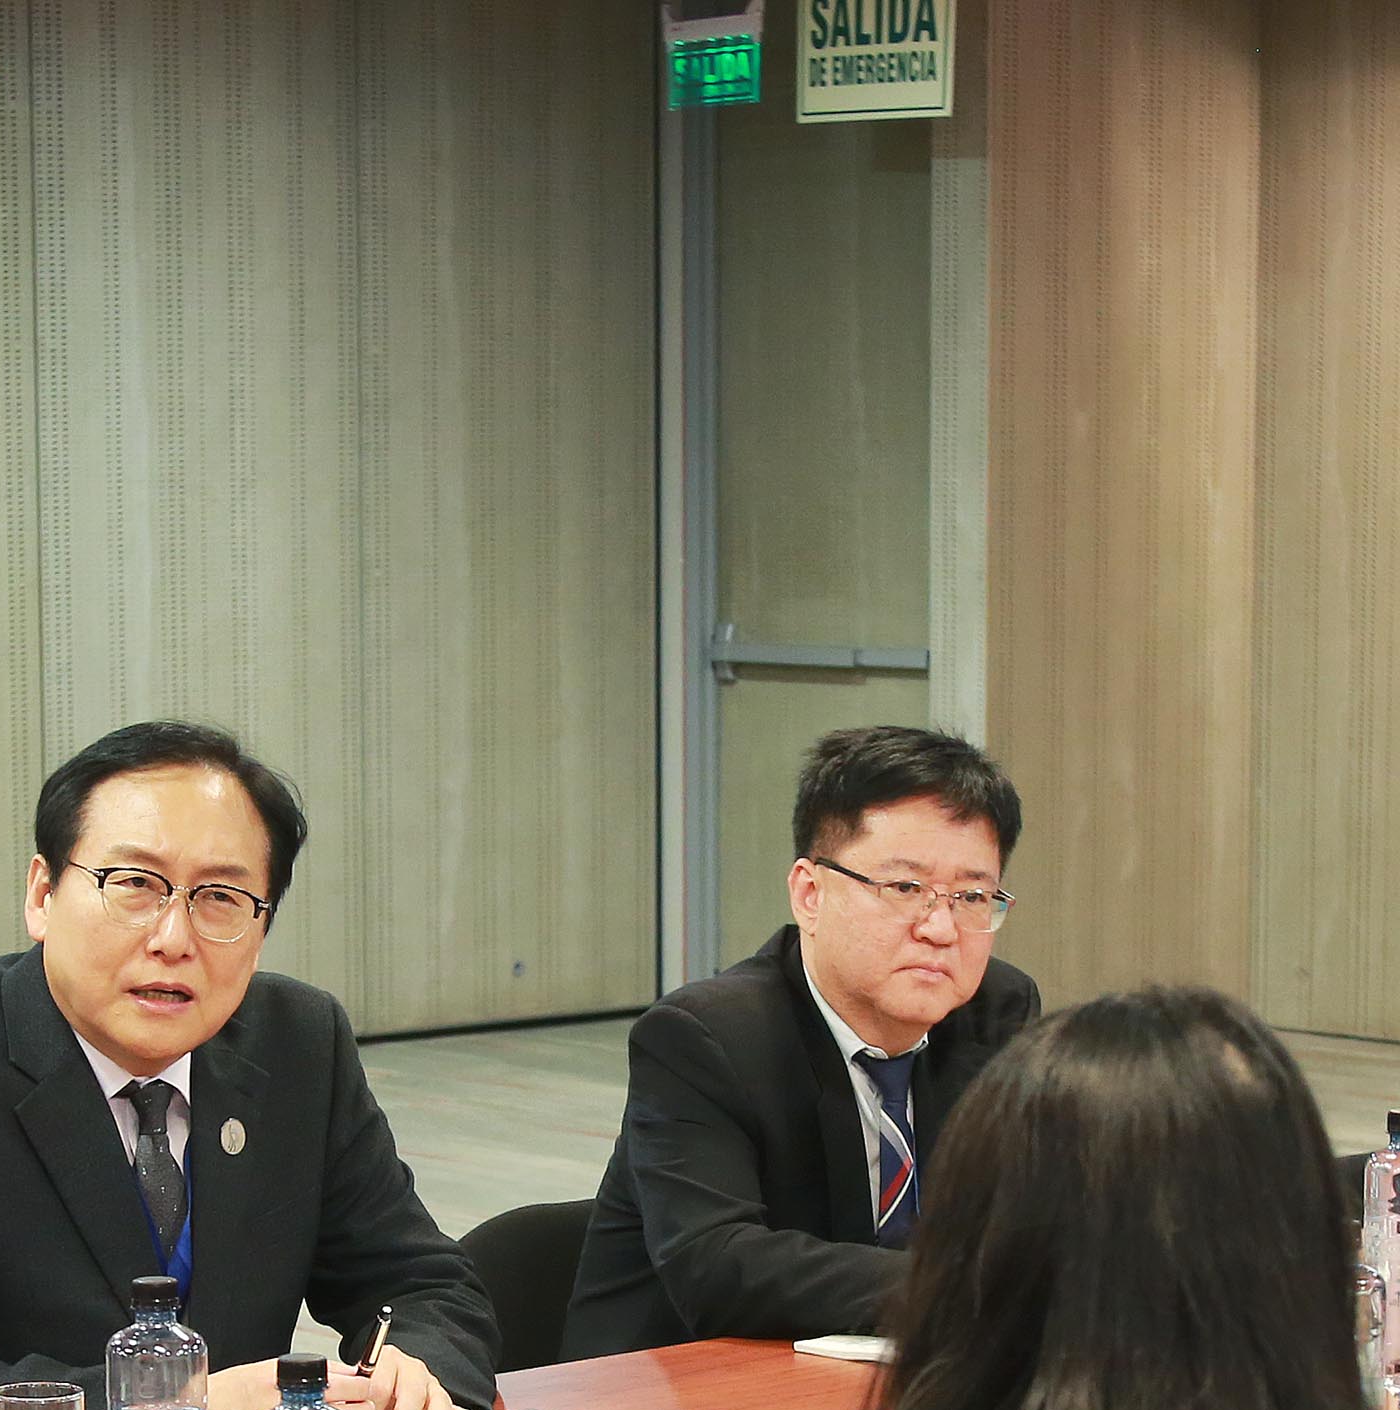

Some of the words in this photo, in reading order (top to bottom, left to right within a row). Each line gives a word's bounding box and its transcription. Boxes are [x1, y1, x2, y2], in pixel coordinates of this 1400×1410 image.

[810, 0, 937, 49] SALIDA
[809, 57, 828, 87] DE
[833, 50, 938, 86] EMERGENCIA
